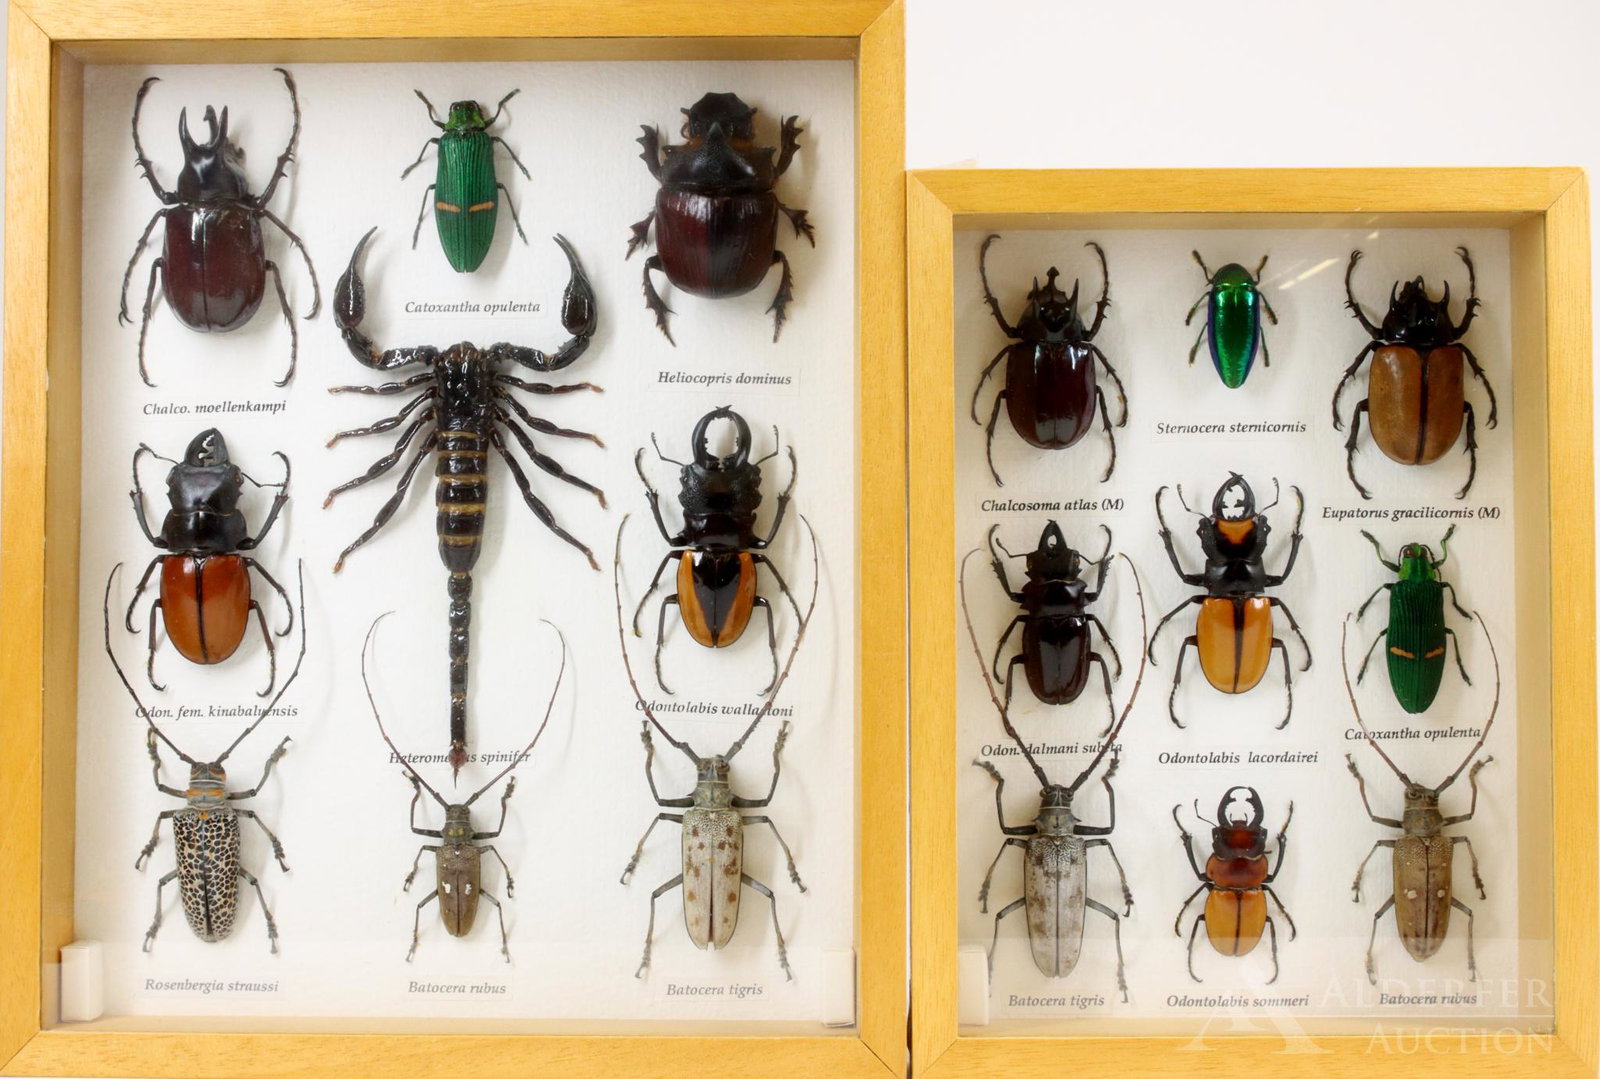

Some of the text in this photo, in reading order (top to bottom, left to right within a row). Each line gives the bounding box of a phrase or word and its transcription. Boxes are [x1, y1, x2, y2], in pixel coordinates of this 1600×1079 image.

[405, 300, 541, 316] Catoxantha opulenta
[657, 371, 792, 387] Heliocopris dominus
[143, 400, 287, 415] Chalco. moellenkampi
[1157, 421, 1307, 434] Sternocera sternicornis
[981, 498, 1125, 512] Chalcosoma atlas (M)
[1322, 507, 1501, 521] Eupatorus gracilicornis (M)
[135, 705, 174, 718] Odon.
[176, 705, 204, 721] fem.
[635, 700, 794, 717] Odontolabis wallatoni
[1344, 727, 1481, 742] Catoxantha opulenta
[980, 744, 1020, 757] Odon.
[1023, 742, 1078, 756] dalmani
[1158, 751, 1319, 764] Odontolabis lacordairei
[145, 979, 279, 994] Rosenbergia straussi
[408, 981, 507, 994] Batocera rubus
[666, 984, 763, 999] Batocera tigris
[1008, 995, 1105, 1009] Batocera tigris
[1167, 995, 1310, 1007] Odontolabis sommeri
[1379, 993, 1478, 1005] Batocera rubus
